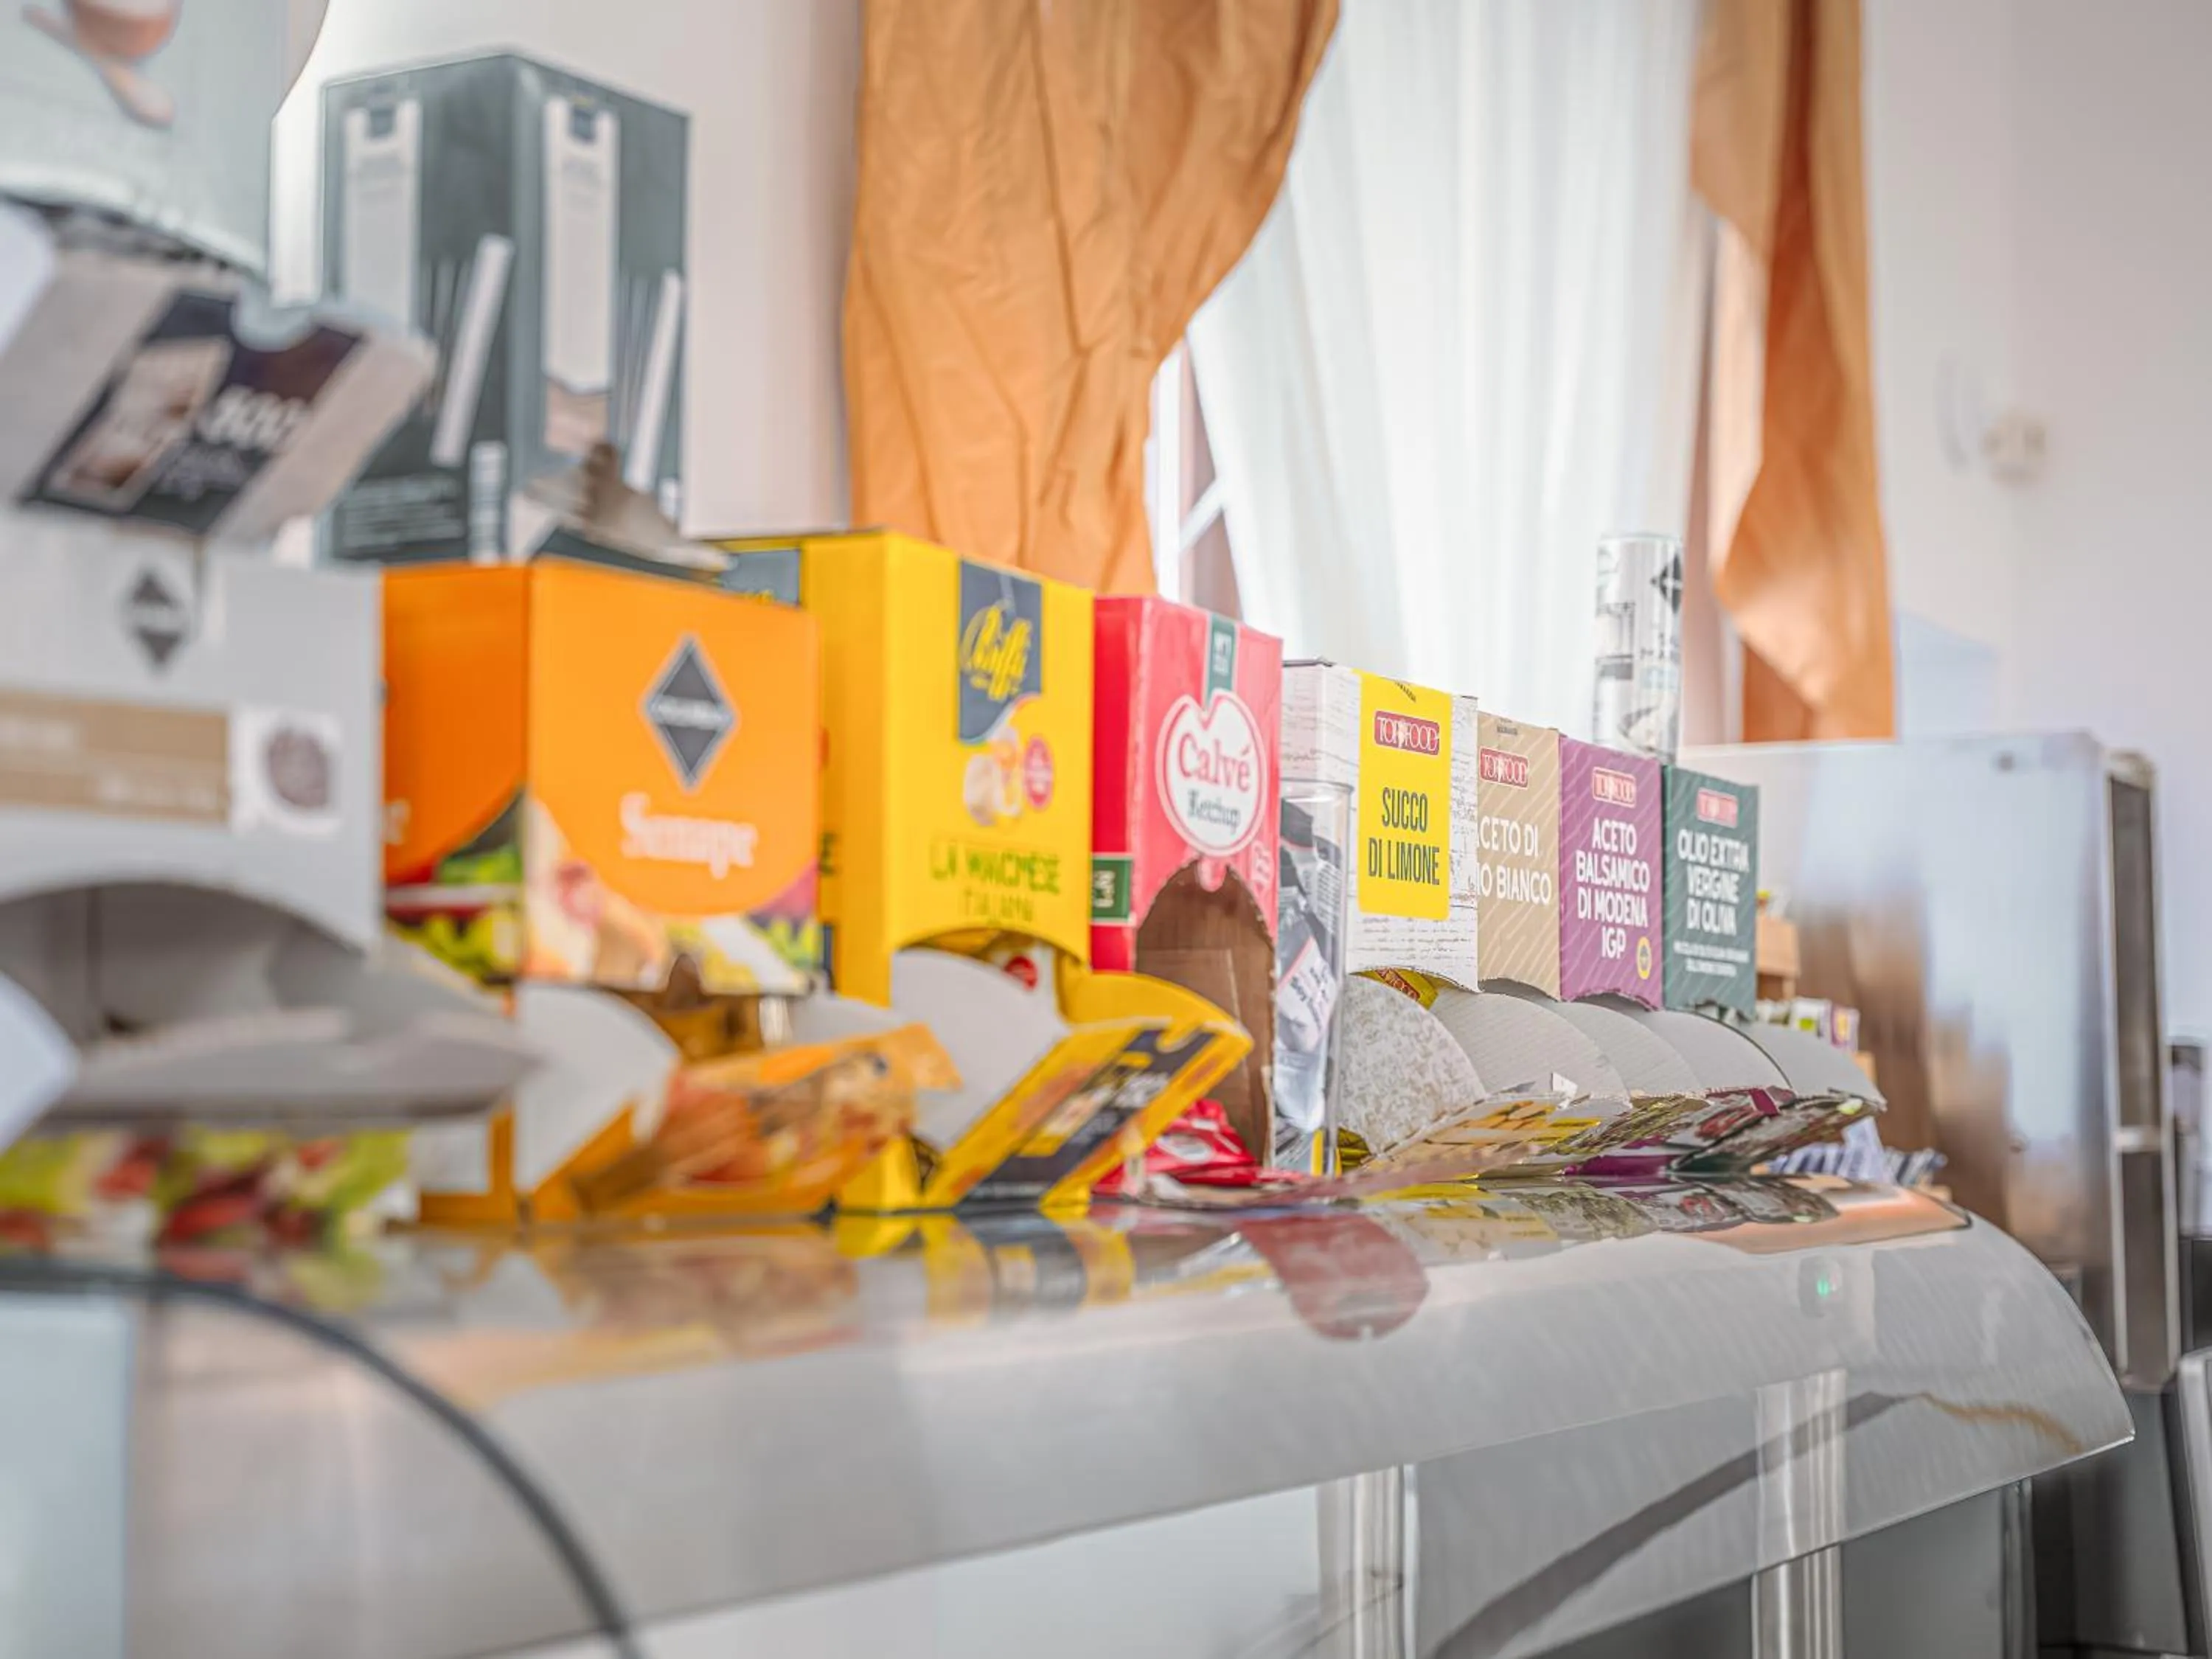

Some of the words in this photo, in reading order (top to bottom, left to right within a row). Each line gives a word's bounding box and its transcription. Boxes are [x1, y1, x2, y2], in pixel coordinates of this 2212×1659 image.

[1179, 732, 1251, 793] Calvé
[1381, 787, 1428, 832] SUCCO
[1477, 815, 1521, 855] CETO
[1524, 824, 1539, 858] DI
[1593, 817, 1637, 855] ACETO
[1677, 828, 1709, 864] OLIO
[1710, 833, 1750, 873] EXTRA
[1368, 837, 1382, 878] DI
[1388, 840, 1440, 886] LIMONE
[1576, 849, 1650, 893] BALSAMICO
[1496, 864, 1552, 905] BIANCO
[1686, 863, 1740, 905] VERGINE
[1577, 886, 1591, 920] DI
[1594, 889, 1649, 928] MODENA
[1686, 897, 1700, 931] DI
[1702, 901, 1737, 937] OLIVA
[1601, 926, 1627, 959] IGP
